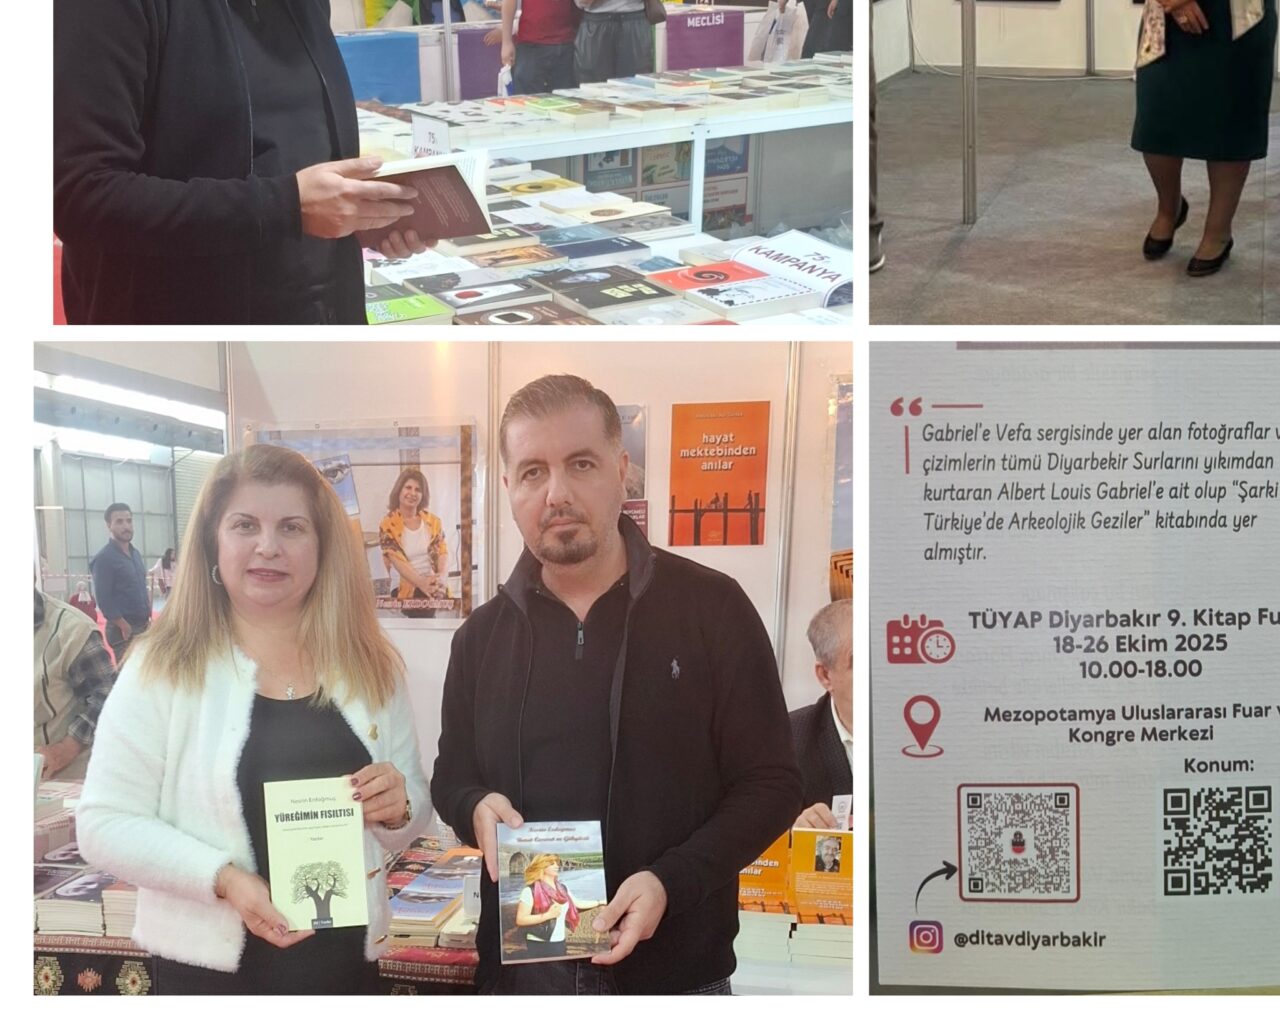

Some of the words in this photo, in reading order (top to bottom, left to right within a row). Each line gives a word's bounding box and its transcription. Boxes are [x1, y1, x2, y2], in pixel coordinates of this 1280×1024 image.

[687, 12, 724, 27] MECLİSİ
[750, 245, 843, 284] KAMPANYA
[702, 433, 735, 444] hayat
[922, 422, 991, 442] Gabriel'e
[996, 422, 1032, 442] Vefa
[1036, 421, 1114, 446] sergisinde
[1117, 427, 1144, 446] yer
[1147, 421, 1182, 441] alan
[1187, 420, 1272, 445] fotoğraflar
[680, 446, 756, 458] mektebinden
[701, 459, 734, 471] anılar
[922, 451, 996, 477] çizimlerin
[1000, 453, 1042, 472] tümü
[1047, 451, 1129, 476] Diyarbekir
[1132, 450, 1199, 471] Surlarını
[1203, 450, 1274, 475] yıkımdan
[923, 482, 992, 502] kurtaran
[996, 481, 1046, 501] Albert
[1050, 482, 1092, 501] Louis
[1096, 479, 1165, 500] Gabriel'e
[1168, 481, 1190, 500] ait
[1194, 480, 1227, 504] olup
[923, 510, 1005, 536] Türkiye'de
[1007, 510, 1086, 535] Arkeolojik
[1155, 509, 1228, 529] kitabında
[1232, 514, 1258, 533] yer
[923, 541, 987, 566] almıştır.
[968, 607, 1043, 630] TÜYAP
[1049, 608, 1162, 634] Diyarbakır
[1167, 608, 1187, 627] 9.
[1193, 607, 1252, 631] Kitap
[1053, 635, 1110, 654] 18-26
[1115, 634, 1168, 653] Ekim
[1174, 633, 1228, 652] 2025
[1079, 658, 1203, 679] 10.00-18.00
[983, 706, 1116, 726] Mezopotamya
[1121, 703, 1227, 721] Uluslararası
[1232, 703, 1272, 719] Fuar
[1068, 727, 1136, 747] Kongre
[1140, 724, 1214, 742] Merkezi
[1184, 757, 1254, 774] Konum:
[274, 811, 319, 823] YÜREĞİMİN
[320, 808, 354, 818] FISILTISI
[953, 929, 1107, 951] @ditavdiyarbakir
